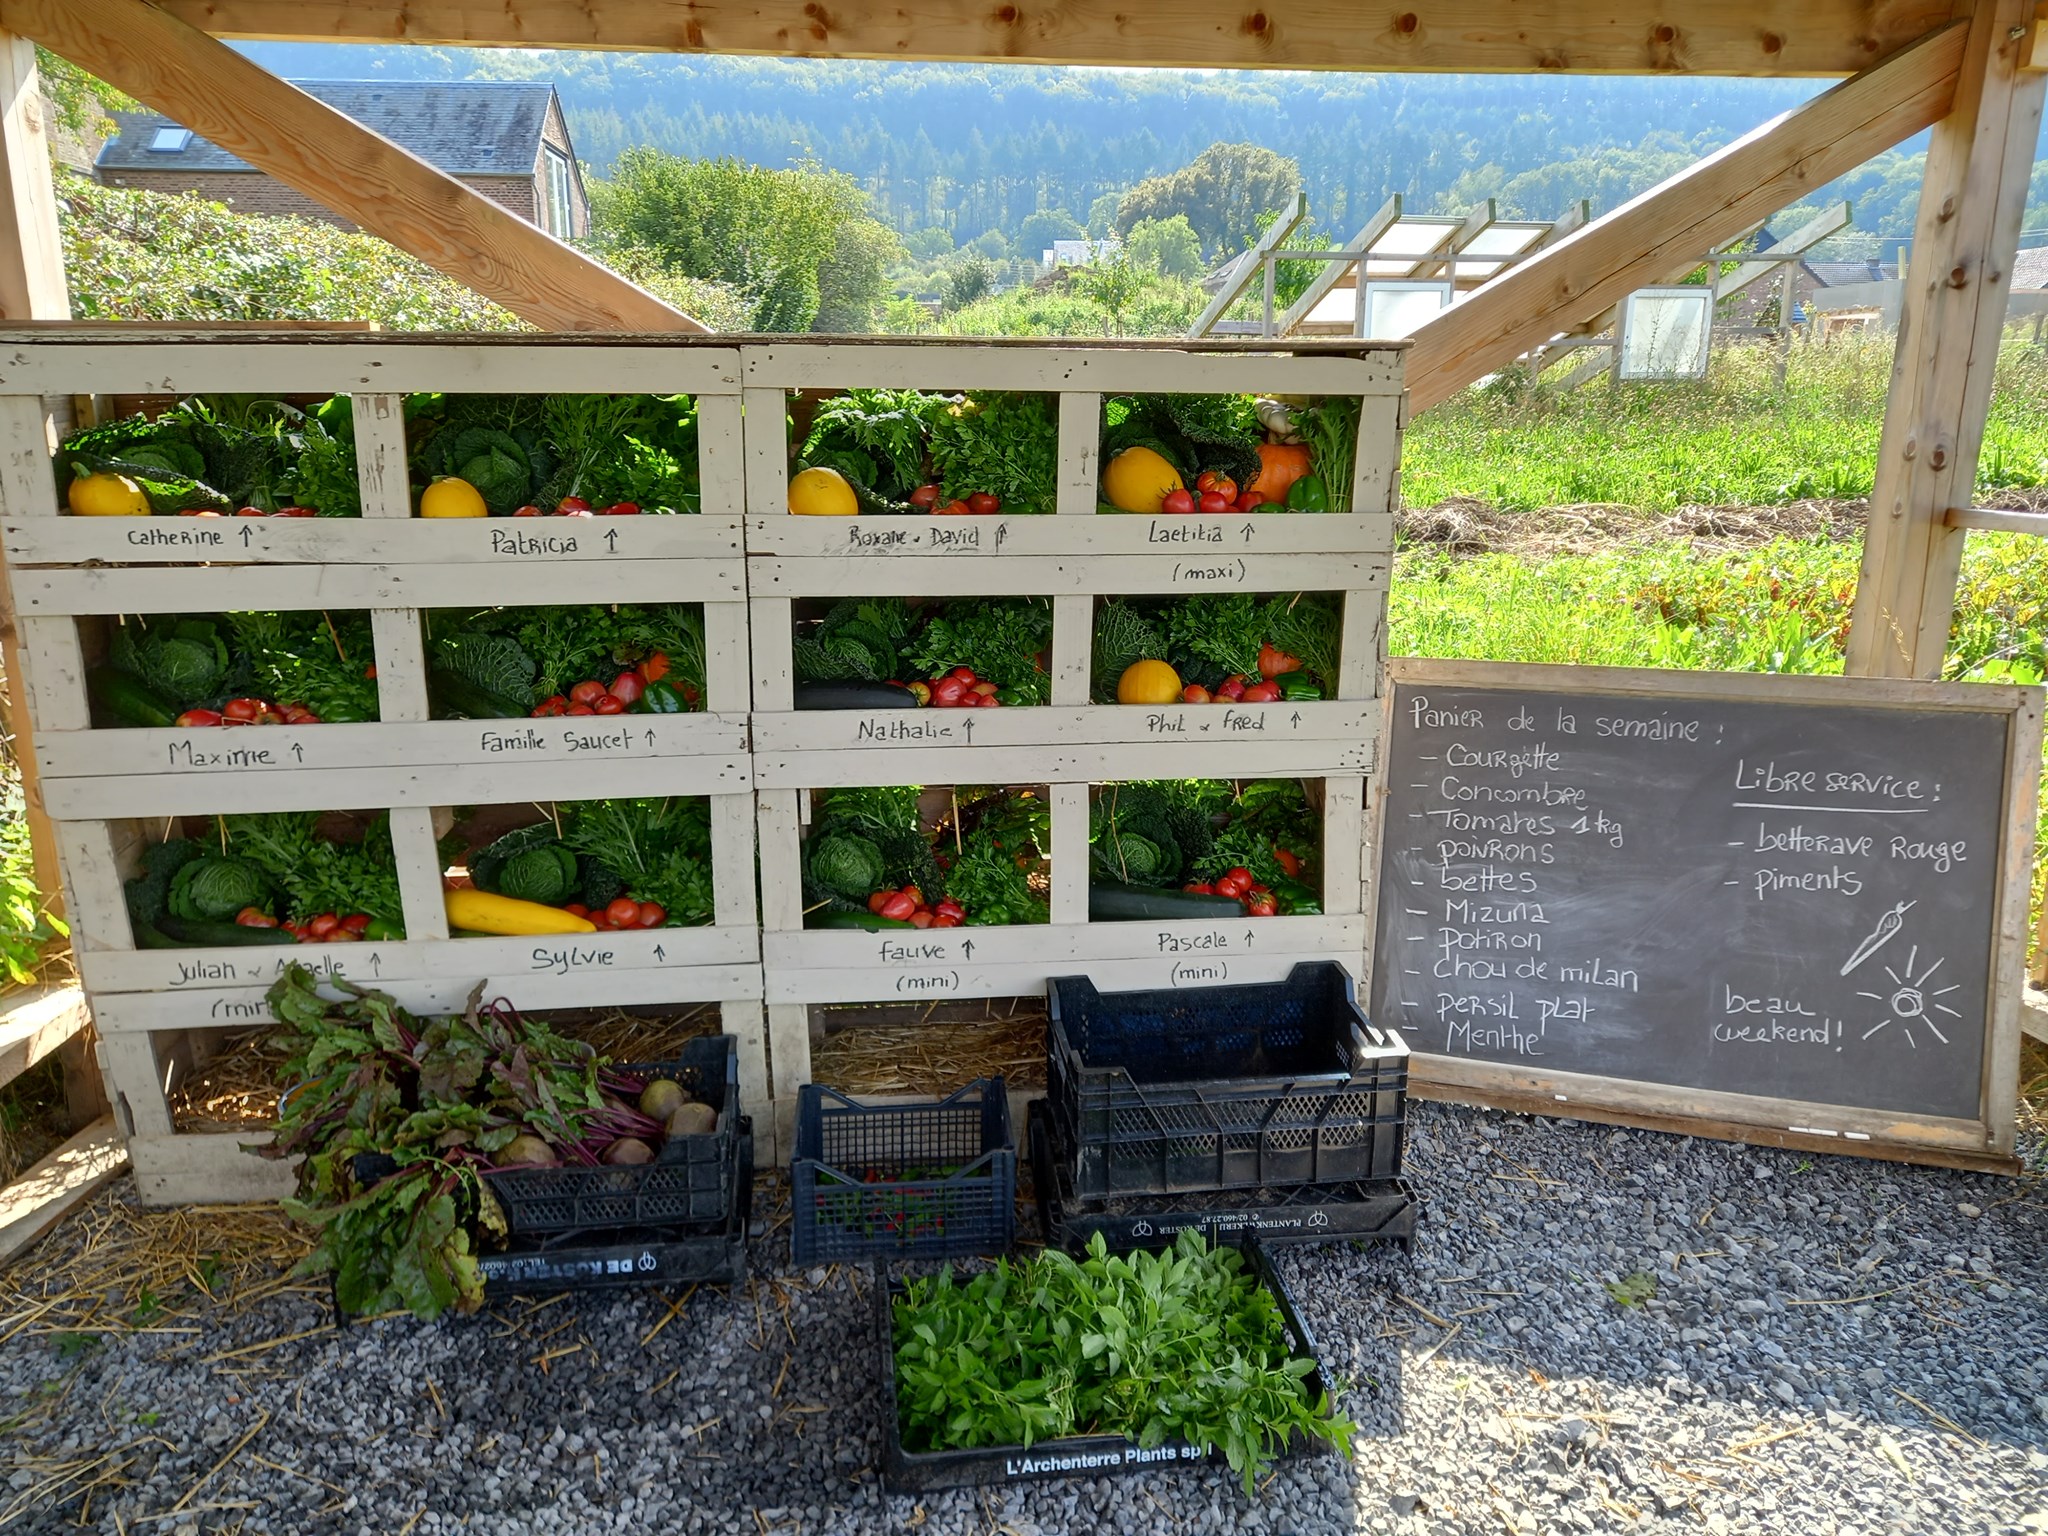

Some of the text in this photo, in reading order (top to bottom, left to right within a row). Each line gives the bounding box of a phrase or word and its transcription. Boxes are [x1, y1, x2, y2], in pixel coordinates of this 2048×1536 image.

[128, 528, 224, 546] Catherine
[490, 529, 578, 555] Patricia
[929, 526, 980, 546] David
[1148, 520, 1223, 543] Laetitia
[1172, 558, 1246, 582] (maxi)
[858, 718, 953, 741] Nathalie
[1409, 695, 1484, 728] Panier
[1508, 705, 1535, 733] de
[1558, 706, 1576, 734] la
[1596, 710, 1699, 742] semaine
[169, 740, 276, 767] Maxime
[481, 728, 633, 752] Famille Saucet
[1446, 742, 1560, 778] Courgette
[1441, 776, 1586, 806] Concombre
[1735, 759, 1816, 793] Libre
[1825, 770, 1924, 799] service
[1427, 808, 1555, 836] Tomates
[1754, 822, 1873, 857] betterave
[1891, 835, 1967, 874] Rouge
[1441, 865, 1537, 892] bettes
[1446, 899, 1550, 924] Mizuna
[1158, 932, 1228, 952] Pascale
[169, 960, 236, 985] Julian
[276, 954, 346, 977] Aaelle
[532, 947, 613, 974] Sylvie
[1171, 961, 1228, 987] (mini)
[1515, 956, 1548, 980] de
[896, 971, 960, 992] (mini)
[1725, 983, 1816, 1015] beau
[1536, 997, 1596, 1035] plat
[1447, 1020, 1545, 1056] Menthe
[1714, 1017, 1843, 1052] weekend!
[606, 1258, 633, 1274] DE
[1006, 1452, 1121, 1475] L'Archenterre
[1125, 1445, 1177, 1464] Plants
